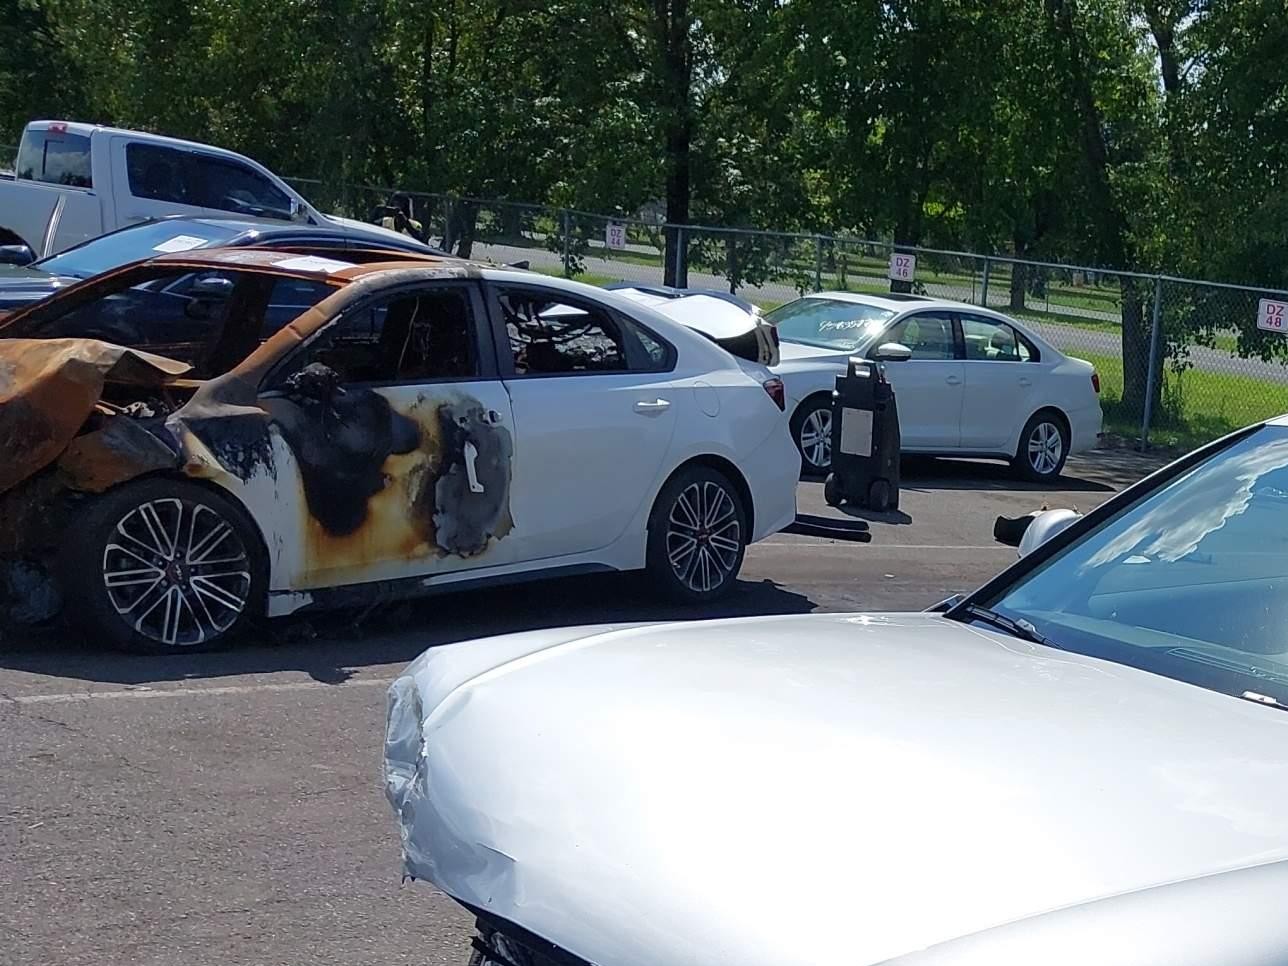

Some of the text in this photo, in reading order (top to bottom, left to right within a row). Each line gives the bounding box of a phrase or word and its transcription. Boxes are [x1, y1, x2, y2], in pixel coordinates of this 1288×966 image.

[896, 257, 910, 268] DZ
[896, 268, 908, 278] 46
[1266, 304, 1285, 317] DZ
[1266, 315, 1282, 328] 48
